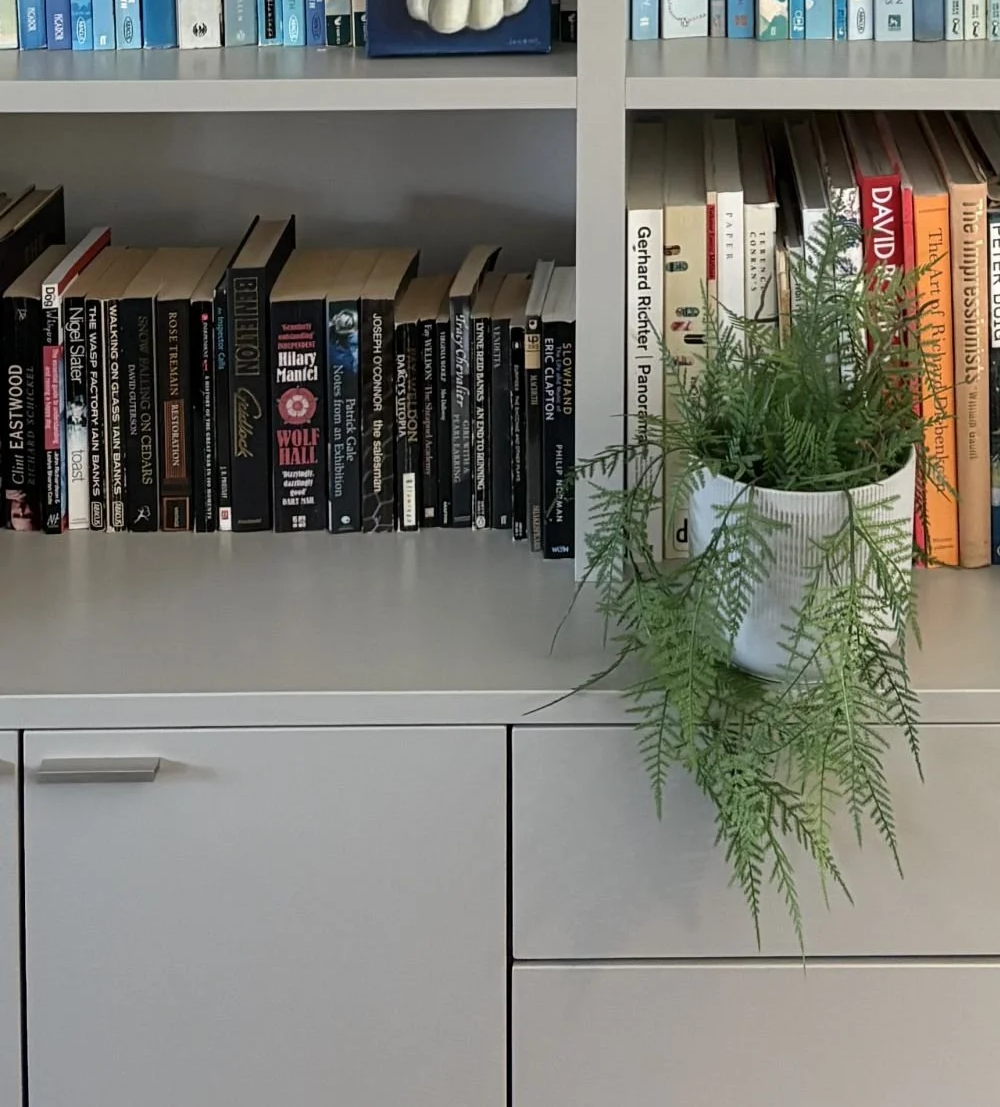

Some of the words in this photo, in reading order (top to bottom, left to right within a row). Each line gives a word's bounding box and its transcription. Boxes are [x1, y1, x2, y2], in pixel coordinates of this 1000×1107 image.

[963, 199, 982, 233] The
[637, 227, 651, 290] Gerhard
[66, 307, 84, 342] Nigel
[89, 306, 97, 330] THE
[637, 296, 651, 350] Richter
[959, 239, 983, 384] Impressionists
[89, 333, 97, 367] WASP
[373, 313, 382, 353] JOSEPH
[544, 338, 554, 365] ERIC
[70, 345, 84, 384] Slater
[277, 366, 318, 383] Mantel
[278, 352, 316, 367] Hilary
[562, 343, 571, 414] SLOWHAND
[90, 371, 99, 423] FACTORY
[373, 356, 382, 411] O'CONNOR
[545, 368, 554, 420] CLAPTON
[638, 364, 651, 443] Panorama
[277, 428, 319, 447] WOLF
[373, 420, 383, 438] the
[72, 450, 86, 482] toast
[279, 446, 318, 465] HALL
[373, 441, 383, 492] salesman
[92, 455, 101, 496] BANKS
